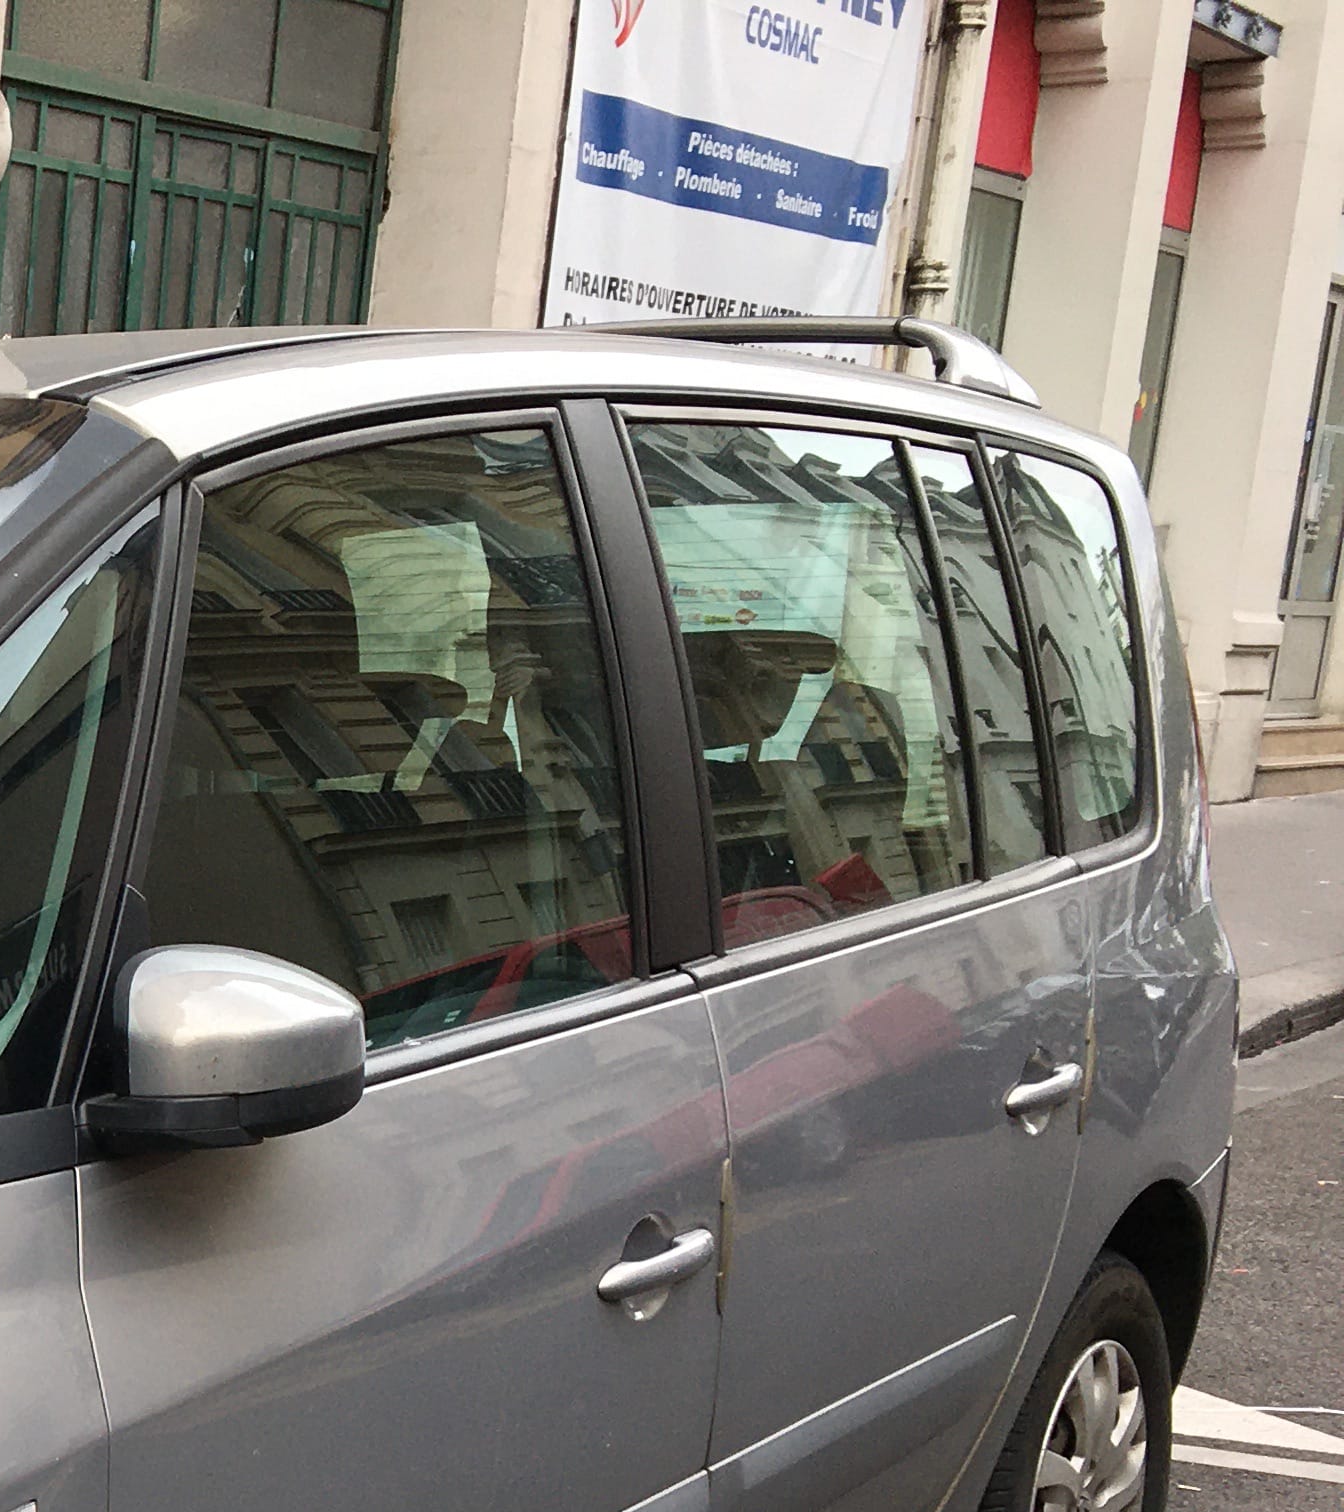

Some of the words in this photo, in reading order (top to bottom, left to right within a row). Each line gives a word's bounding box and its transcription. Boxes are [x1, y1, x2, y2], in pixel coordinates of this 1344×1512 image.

[745, 5, 823, 65] COSMAC
[687, 130, 734, 161] Pièces
[735, 143, 792, 177] détachées
[581, 142, 645, 181] Chauffage
[674, 166, 742, 200] Plomberie
[775, 189, 823, 218] Sanitaire
[847, 206, 878, 230] Froid
[564, 266, 634, 305] HORAIRES
[635, 281, 737, 318] D'OUVERTURE
[739, 301, 758, 318] DE
